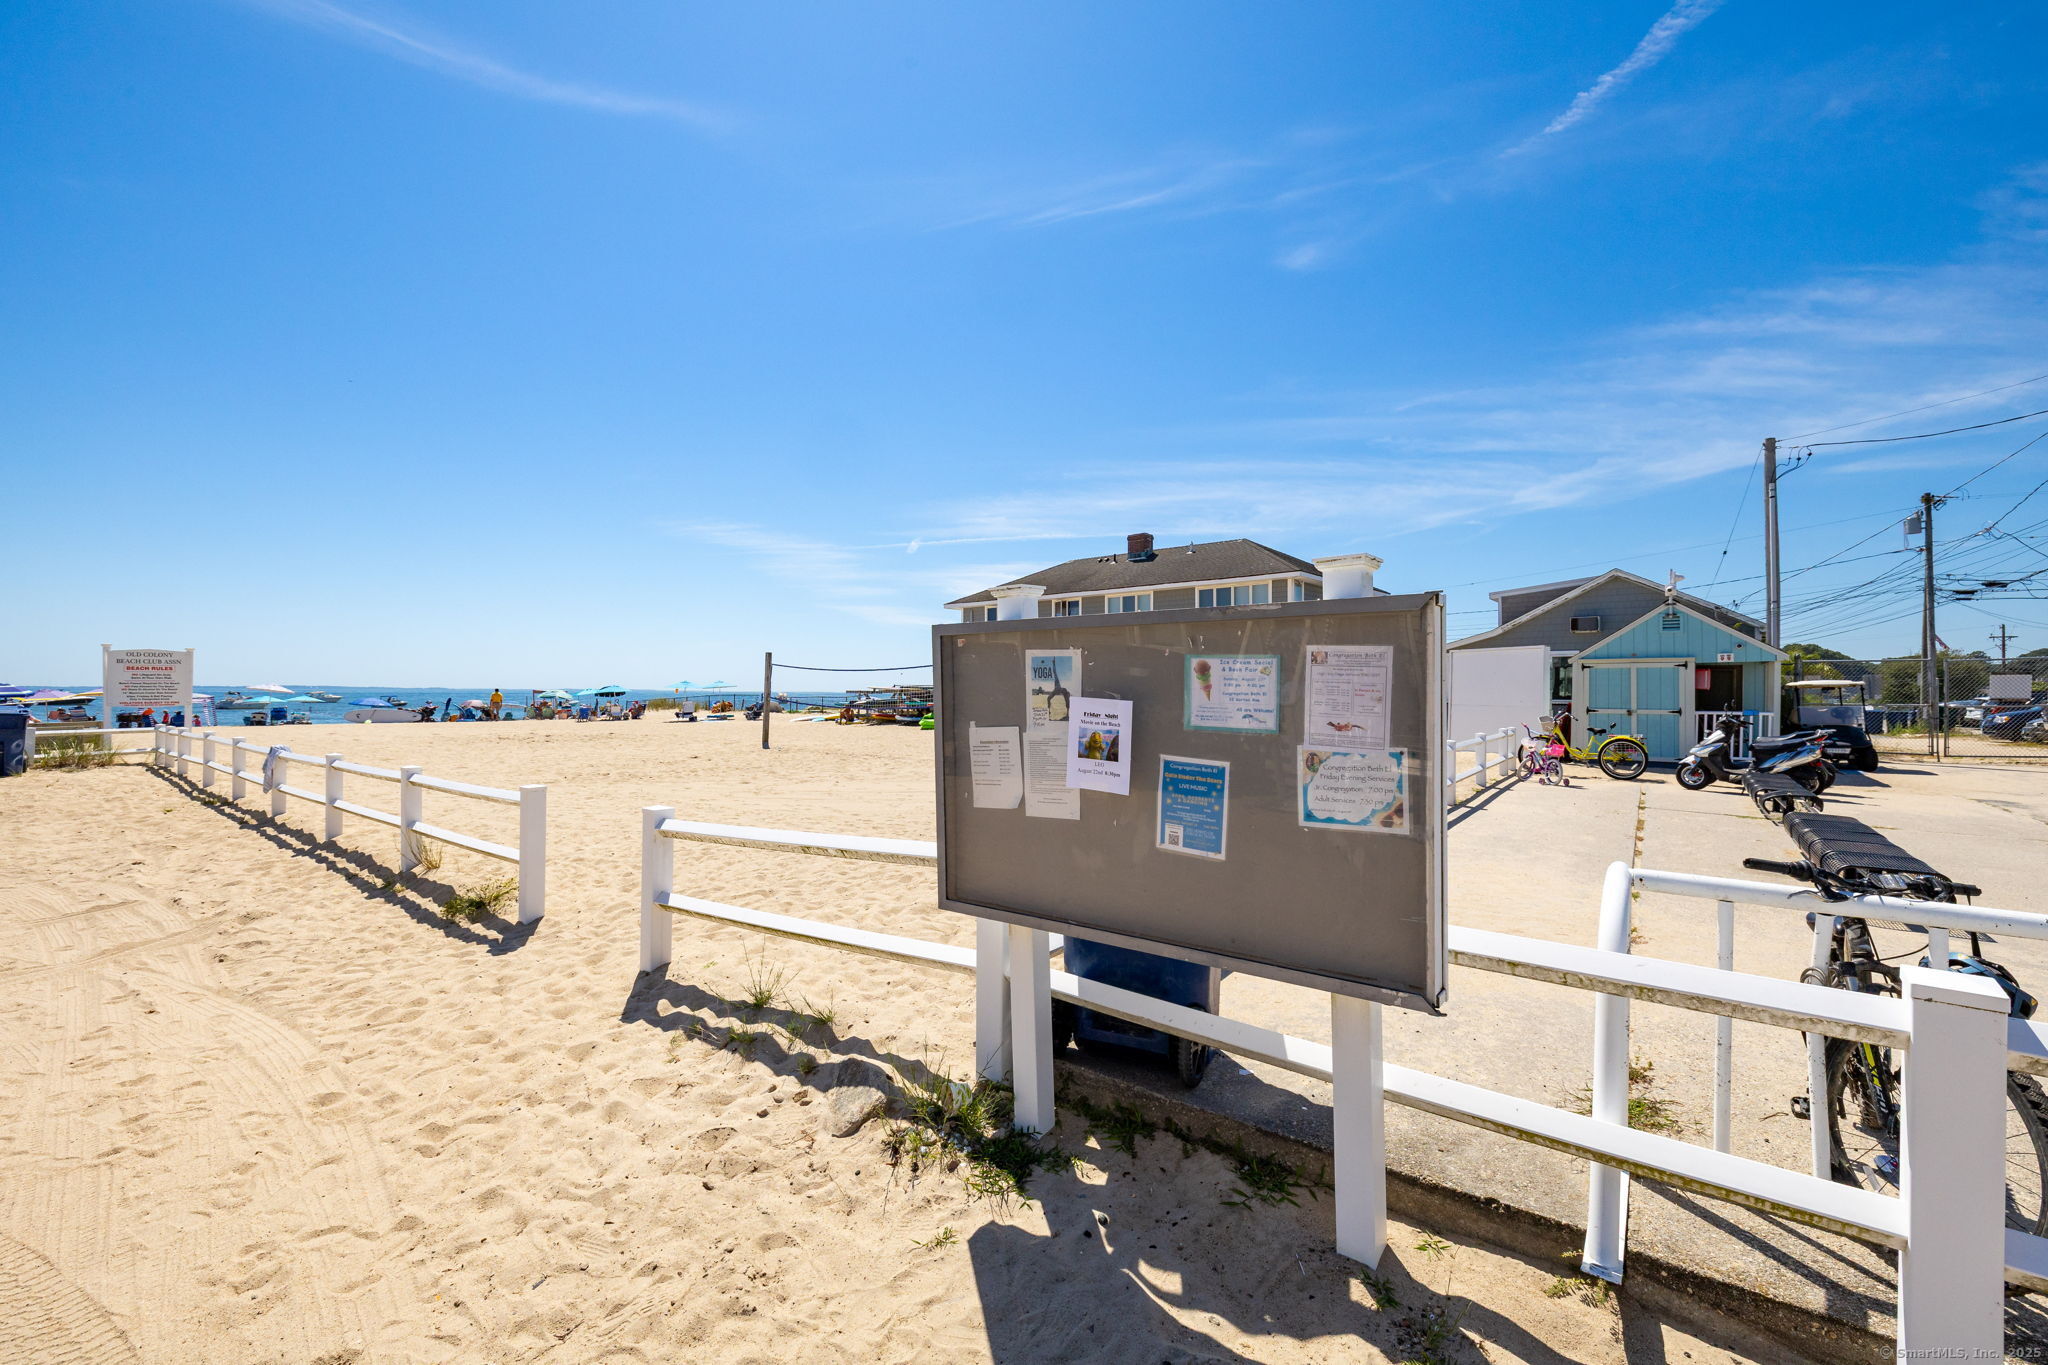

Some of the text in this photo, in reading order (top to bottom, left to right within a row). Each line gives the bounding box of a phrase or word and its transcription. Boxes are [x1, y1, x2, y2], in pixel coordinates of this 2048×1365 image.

[1033, 666, 1052, 678] YOGA
[1322, 764, 1366, 773] Congregation
[1368, 764, 1383, 772] Beth
[1320, 772, 1340, 782] Friday
[1341, 775, 1367, 783] Evening
[1323, 785, 1363, 794] Congregation
